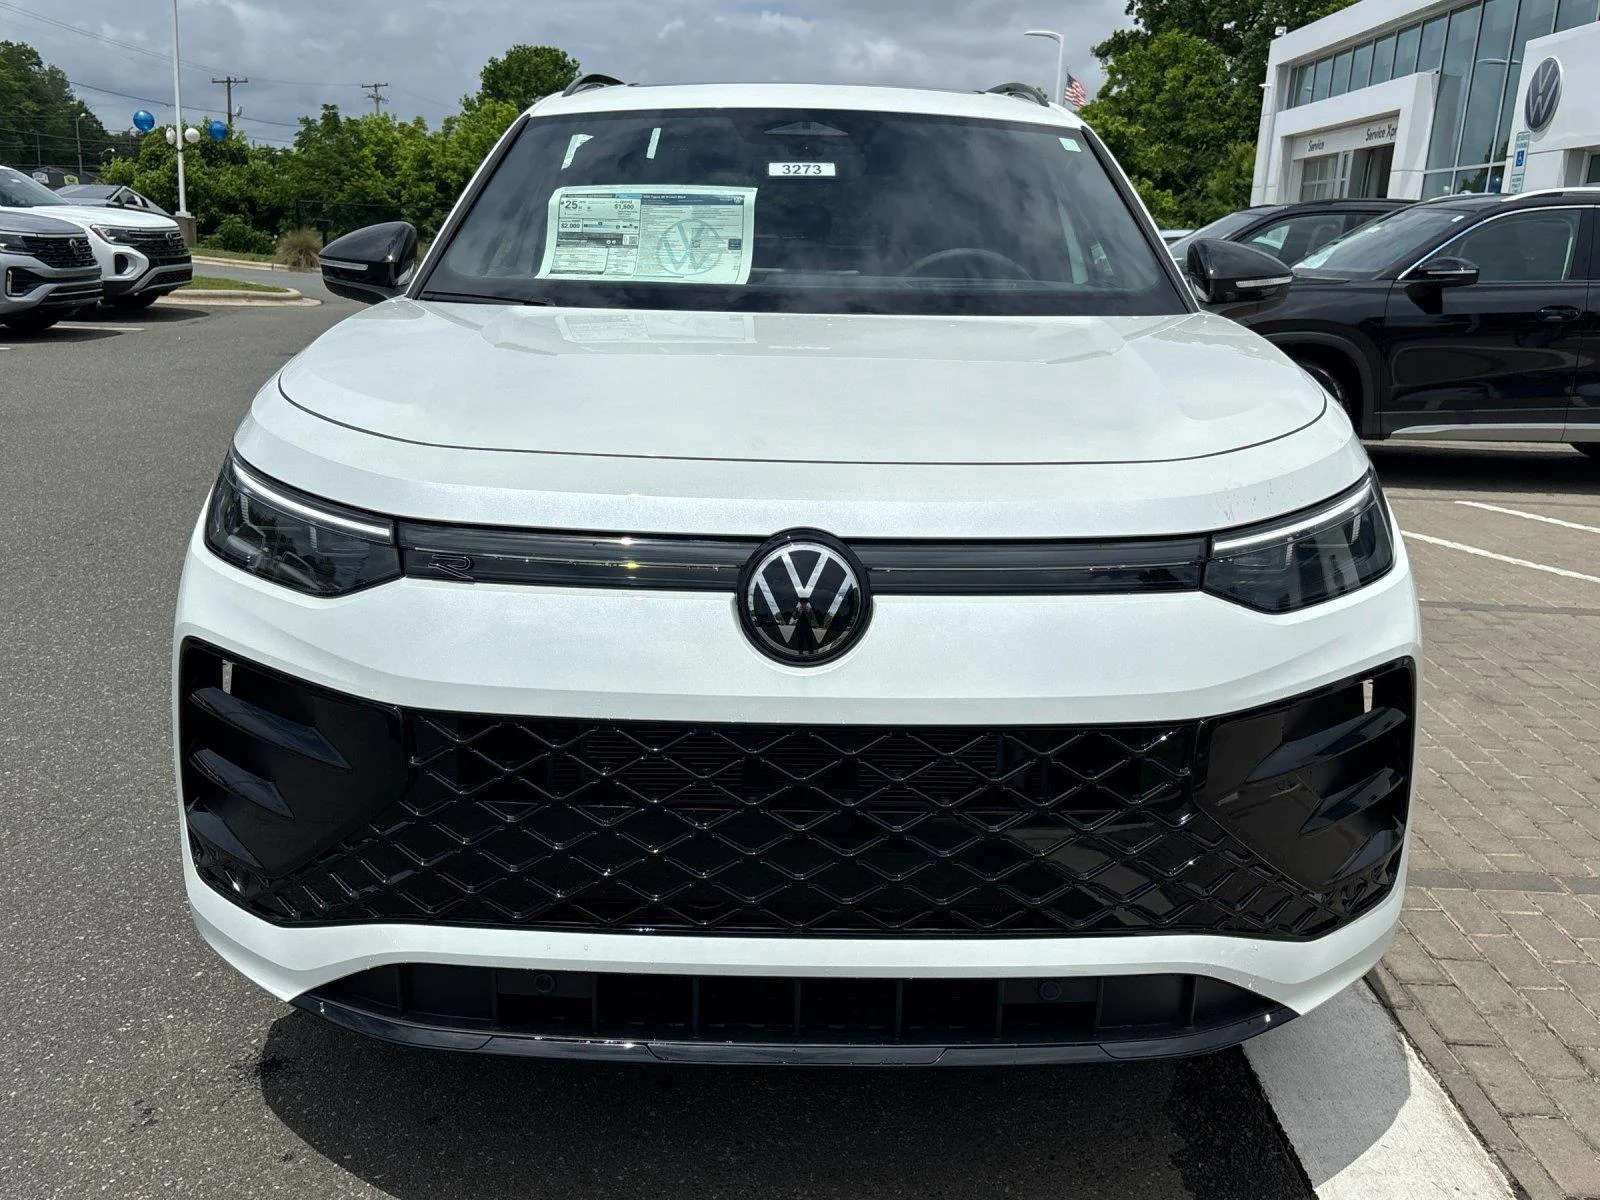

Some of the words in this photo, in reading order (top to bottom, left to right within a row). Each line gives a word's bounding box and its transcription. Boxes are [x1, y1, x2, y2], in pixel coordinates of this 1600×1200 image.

[1365, 126, 1386, 141] Service
[1307, 139, 1325, 152] Service
[782, 164, 822, 175] 3273
[565, 200, 578, 209] 25
